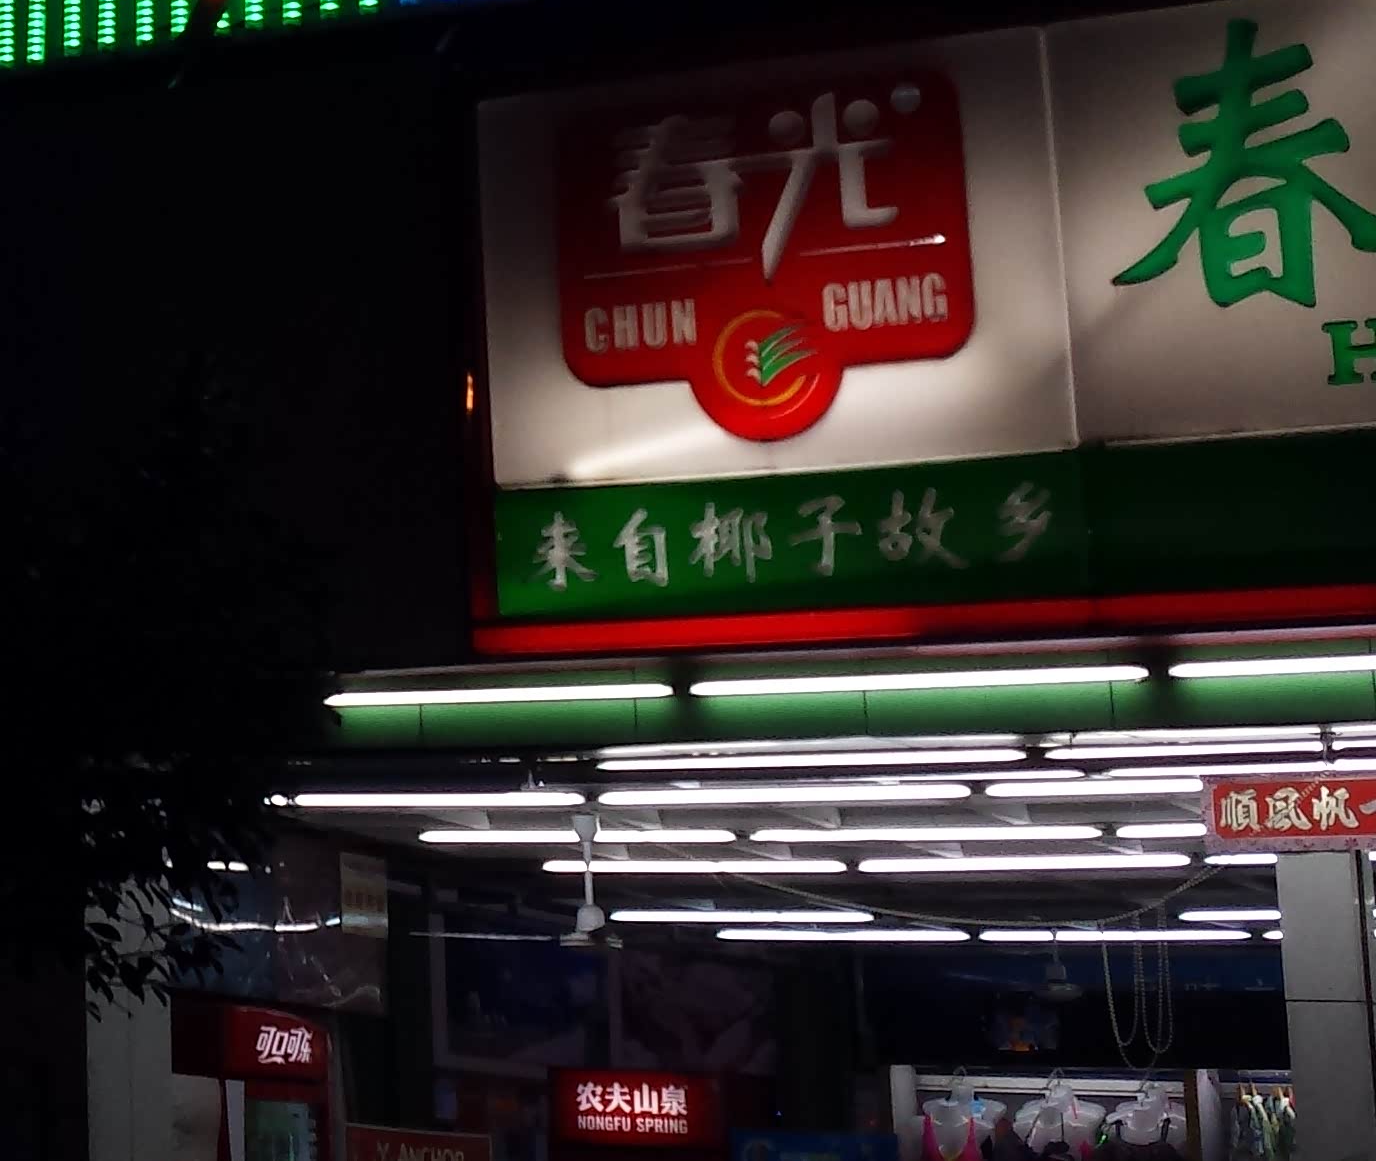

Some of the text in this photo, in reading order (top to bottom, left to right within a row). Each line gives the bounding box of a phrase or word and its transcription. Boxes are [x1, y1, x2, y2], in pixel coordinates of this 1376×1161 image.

[608, 92, 893, 283] 春光
[1112, 19, 1376, 308] 春
[583, 271, 948, 353] CHUN GUANG
[535, 482, 1052, 591] 来自椰子故乡
[576, 1081, 688, 1116] 农夫山泉
[577, 1115, 688, 1134] NONGFU SPRING
